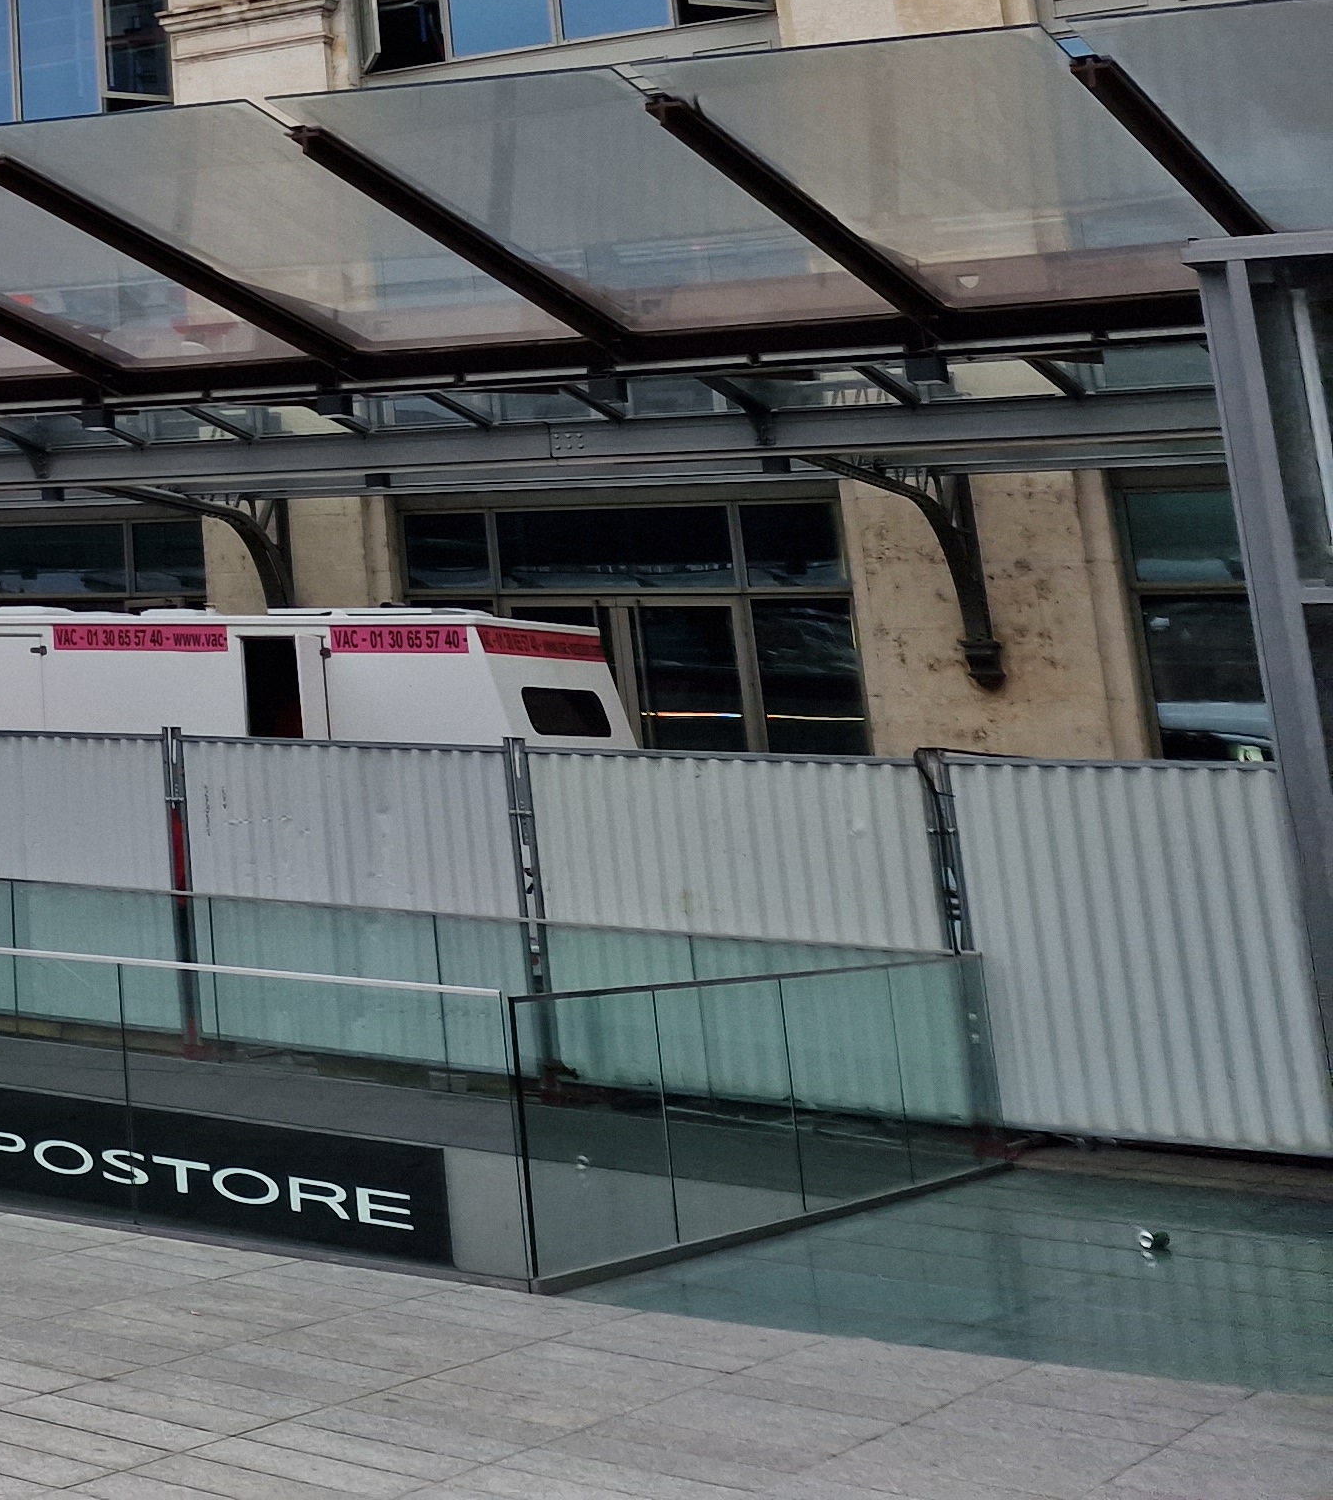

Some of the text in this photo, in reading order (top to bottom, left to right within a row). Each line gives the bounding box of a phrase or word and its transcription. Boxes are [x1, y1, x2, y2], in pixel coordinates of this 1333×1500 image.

[56, 628, 78, 646] VAC
[86, 628, 100, 647] 01
[102, 628, 115, 647] 30
[118, 629, 132, 647] 65
[134, 629, 147, 647] 57
[149, 629, 163, 647] 40
[333, 629, 359, 649] VAC
[369, 629, 384, 649] 01
[388, 630, 403, 649] 30
[406, 630, 423, 649] 65
[425, 630, 440, 649] 57
[444, 630, 460, 649] 40
